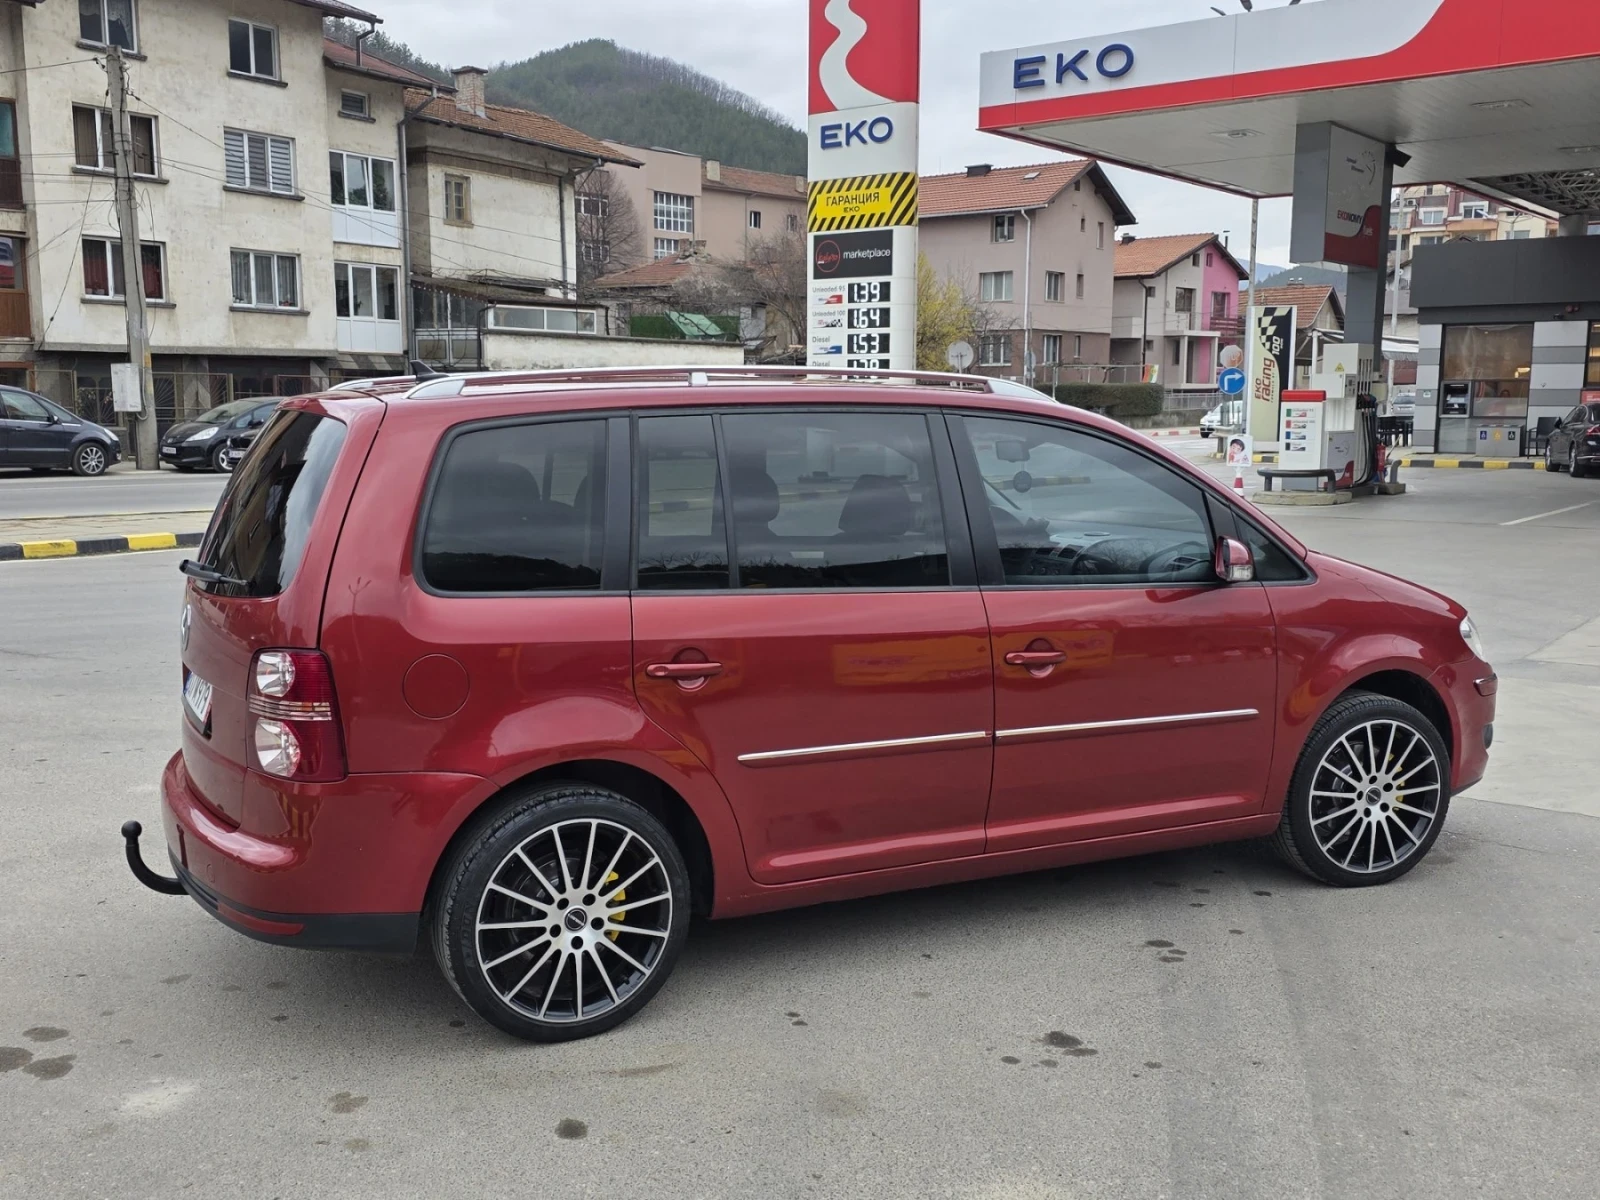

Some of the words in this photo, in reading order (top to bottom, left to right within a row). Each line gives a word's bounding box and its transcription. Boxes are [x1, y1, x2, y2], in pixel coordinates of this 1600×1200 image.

[1014, 43, 1134, 89] EKO
[820, 116, 893, 150] EKO
[826, 192, 880, 206] ГАРАНЦИЯ
[843, 248, 891, 260] marketplace
[812, 285, 837, 293] Unleaded
[1272, 336, 1280, 355] 100
[1262, 357, 1275, 402] racing
